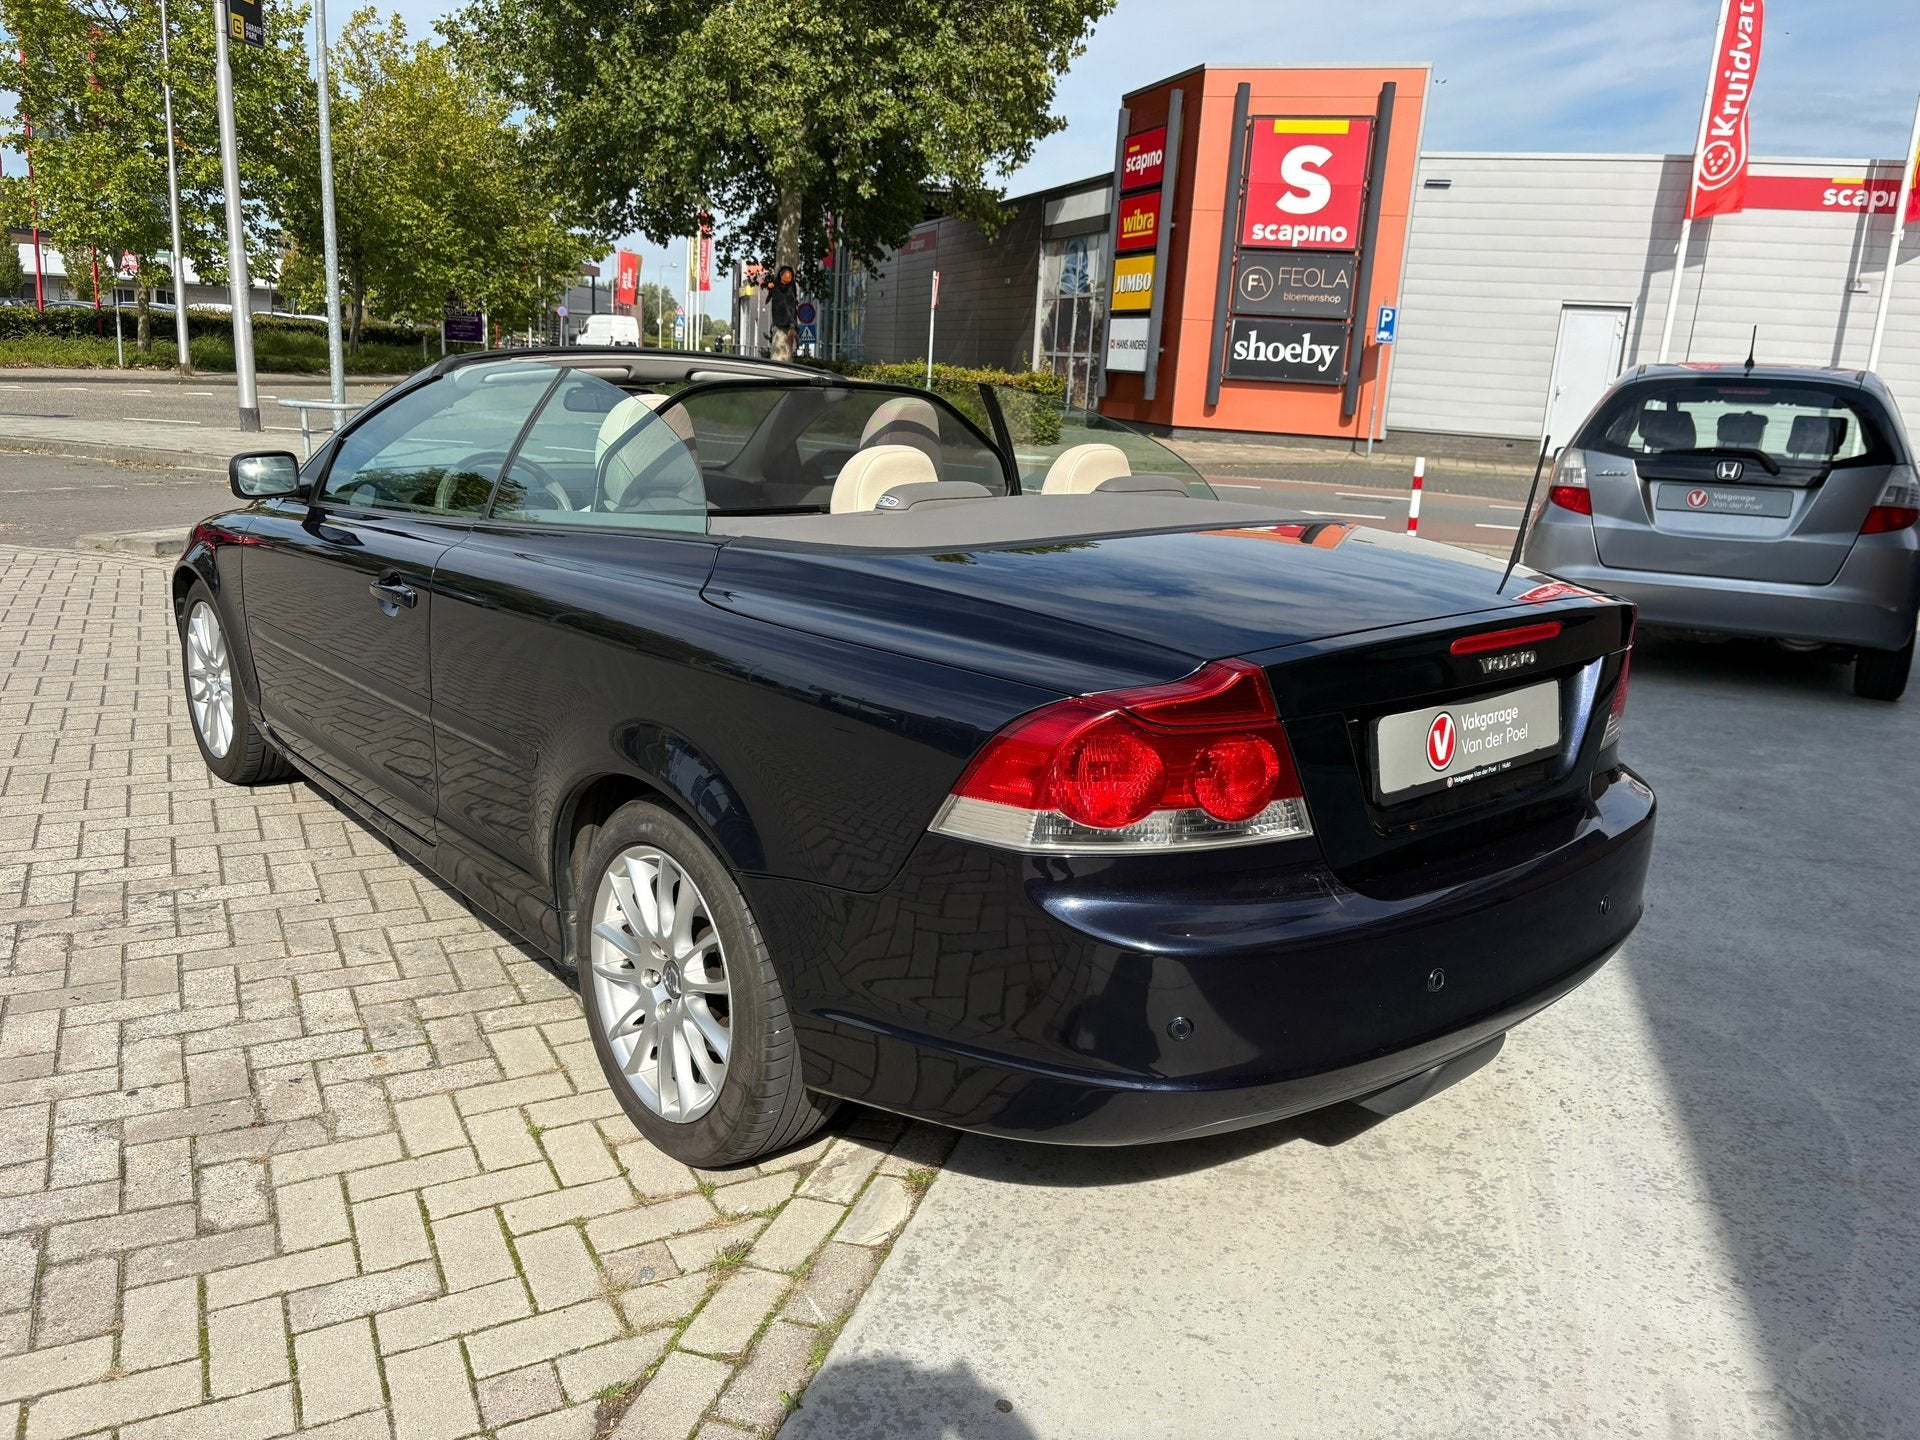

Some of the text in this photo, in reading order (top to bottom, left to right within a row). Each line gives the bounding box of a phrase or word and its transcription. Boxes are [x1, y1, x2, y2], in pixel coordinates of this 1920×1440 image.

[245, 22, 263, 36] GARAGE
[245, 30, 258, 41] PARK
[1710, 0, 1755, 137] Kruidvat
[1125, 149, 1163, 176] scapino
[1822, 188, 1899, 213] scapi
[1123, 208, 1155, 233] wibra
[1251, 223, 1348, 248] scapino
[1115, 272, 1152, 294] JUMBO
[1278, 266, 1350, 289] FEOLA
[1283, 291, 1341, 304] bloemenshop
[1381, 309, 1393, 328] P
[1116, 340, 1147, 350] HANS ANDERS
[1233, 330, 1339, 372] shoeby
[1713, 492, 1756, 502] Vakgarage
[1461, 706, 1518, 731] Vakgarage
[1461, 722, 1528, 755] Van der Poel
